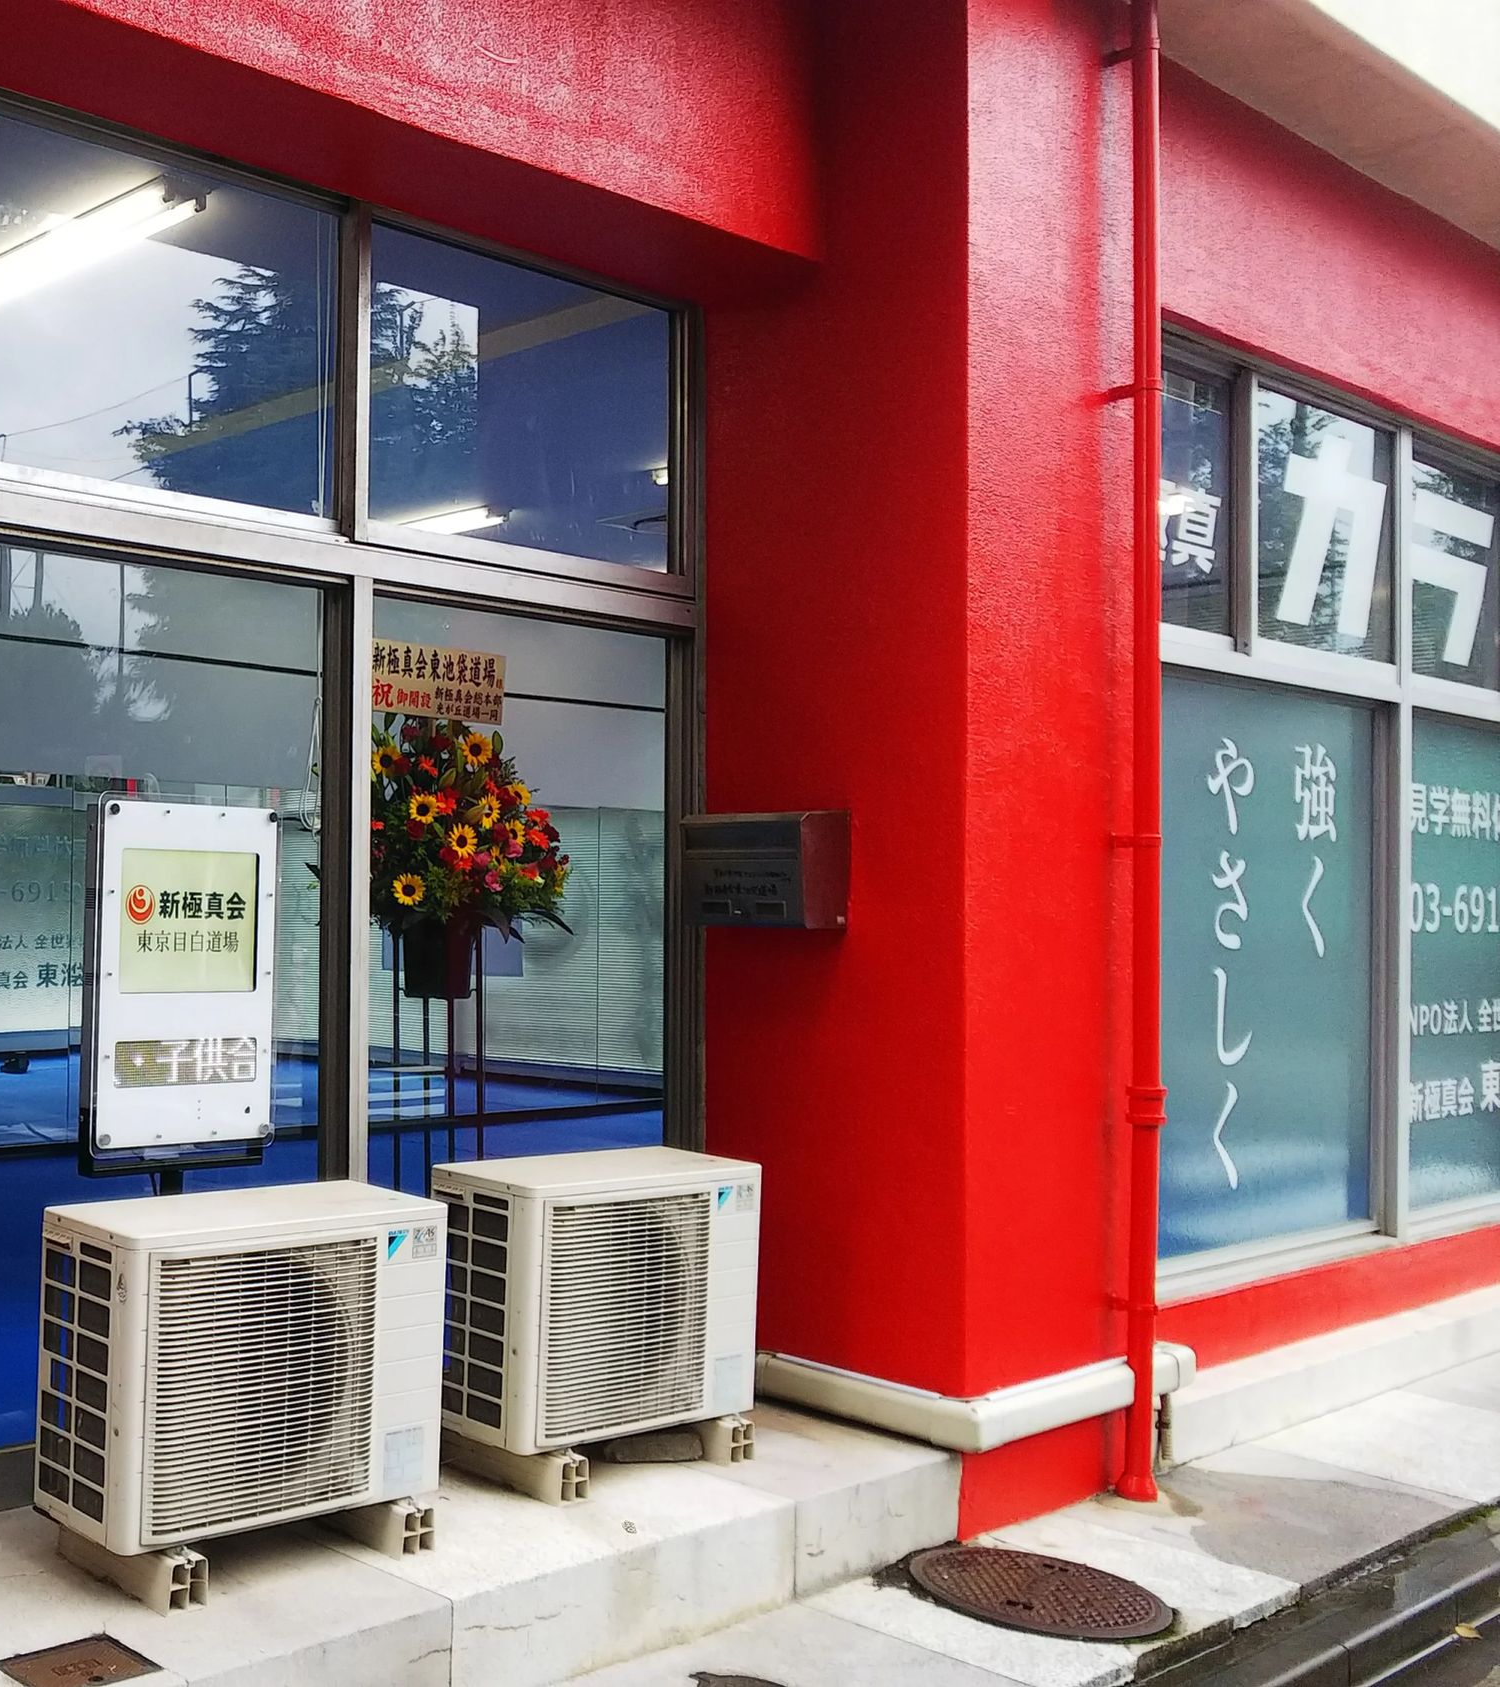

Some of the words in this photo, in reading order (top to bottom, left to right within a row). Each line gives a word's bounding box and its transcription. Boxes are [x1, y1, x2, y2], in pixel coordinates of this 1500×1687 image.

[372, 642, 496, 688] 新極真会東池袋道場
[372, 678, 394, 708] 祝
[1295, 743, 1337, 958] 強く
[158, 890, 246, 921] 新極真会
[1410, 882, 1500, 933] 03-691
[137, 931, 239, 954] 東京目白道場
[1207, 737, 1255, 1190] やさしく
